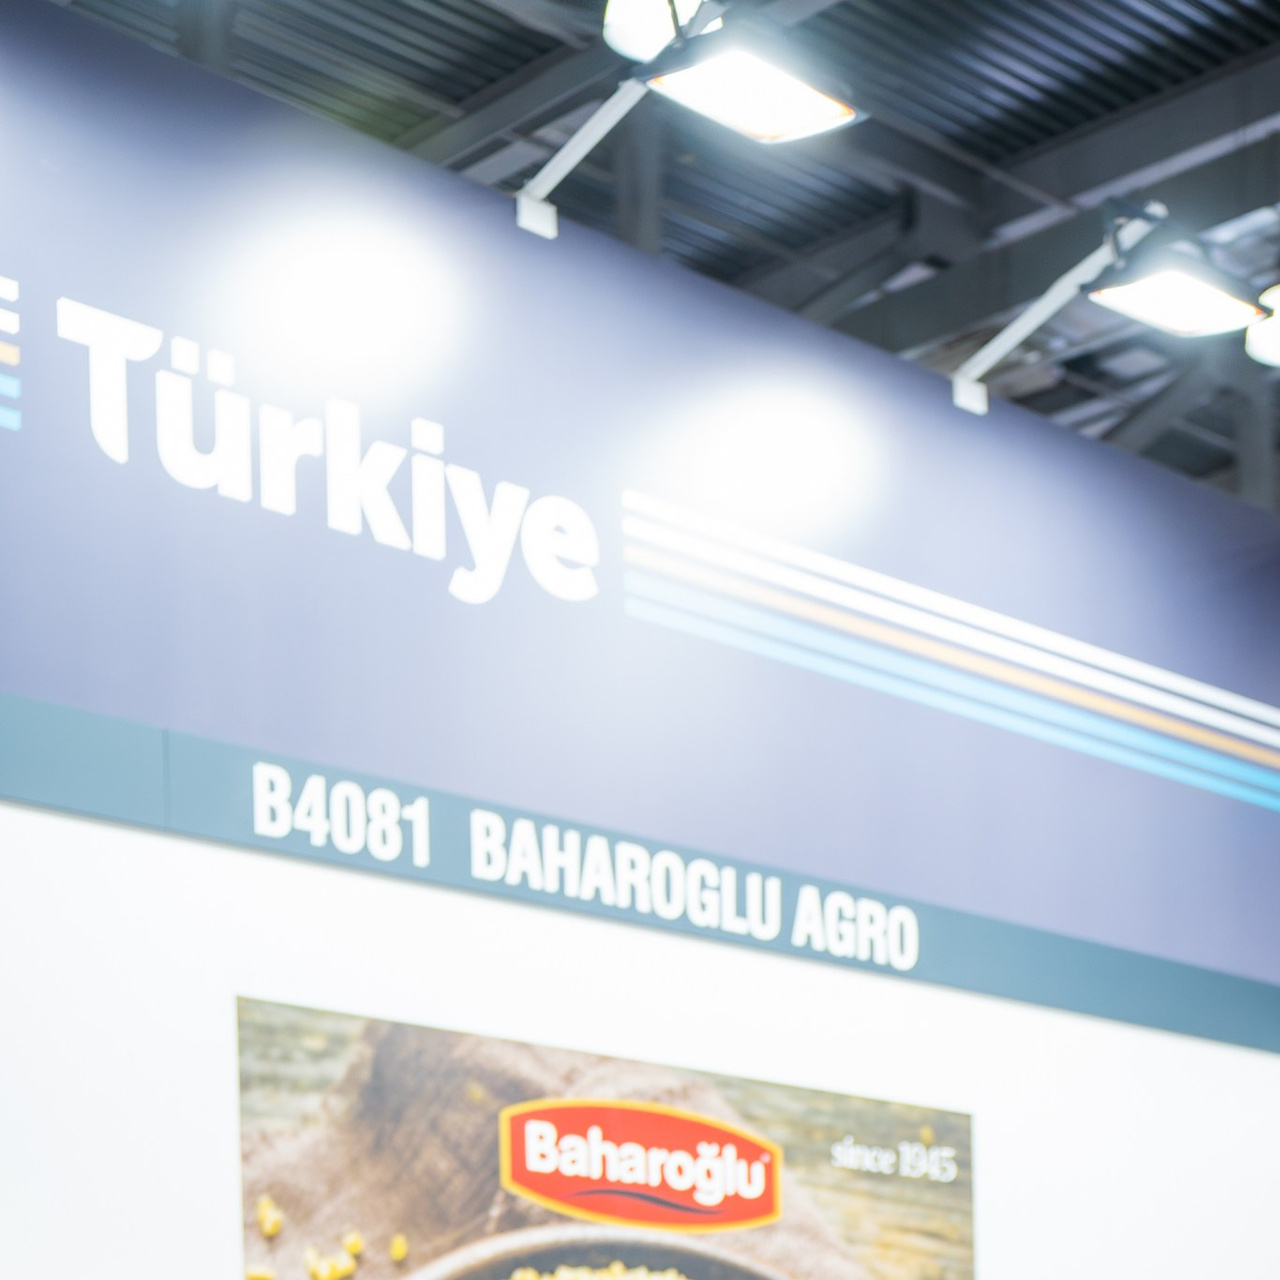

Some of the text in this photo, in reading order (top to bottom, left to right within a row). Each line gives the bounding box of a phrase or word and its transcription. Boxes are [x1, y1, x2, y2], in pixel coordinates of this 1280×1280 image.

[57, 297, 600, 604] Türkiye
[252, 761, 919, 971] B4081 BAHAROGLU AGRO
[524, 1119, 766, 1206] Baharoğlu
